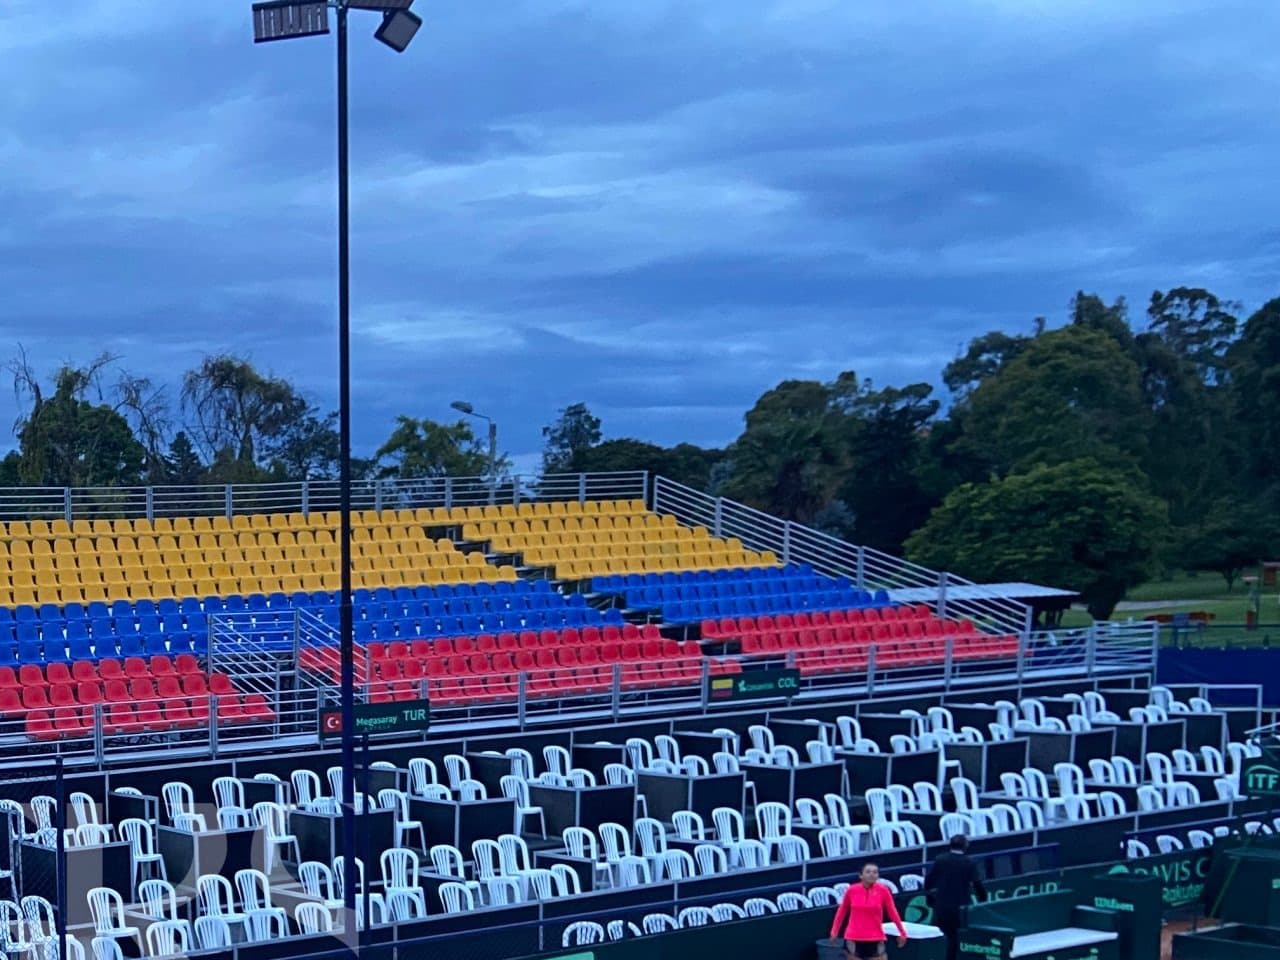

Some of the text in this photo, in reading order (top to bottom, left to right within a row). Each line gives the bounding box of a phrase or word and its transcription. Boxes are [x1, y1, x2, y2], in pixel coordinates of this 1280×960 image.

[778, 677, 798, 688] COL
[403, 709, 426, 721] TUR
[1247, 773, 1280, 789] ITF
